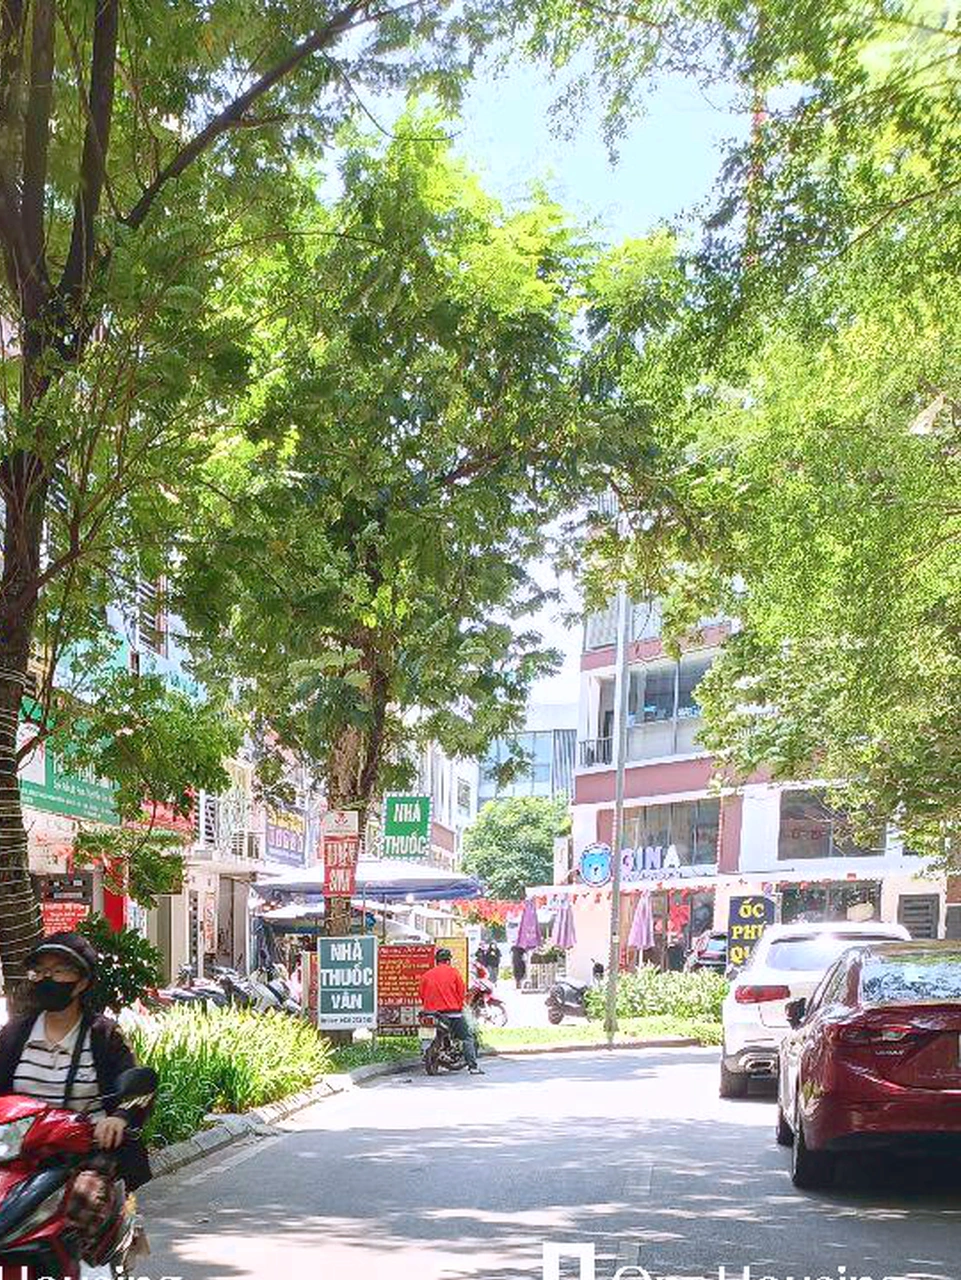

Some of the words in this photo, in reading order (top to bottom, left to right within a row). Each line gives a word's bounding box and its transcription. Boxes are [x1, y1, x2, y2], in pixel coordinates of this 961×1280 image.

[330, 939, 363, 962] NHÀ
[321, 962, 373, 987] THUỐC
[331, 991, 363, 1010] VÂN
